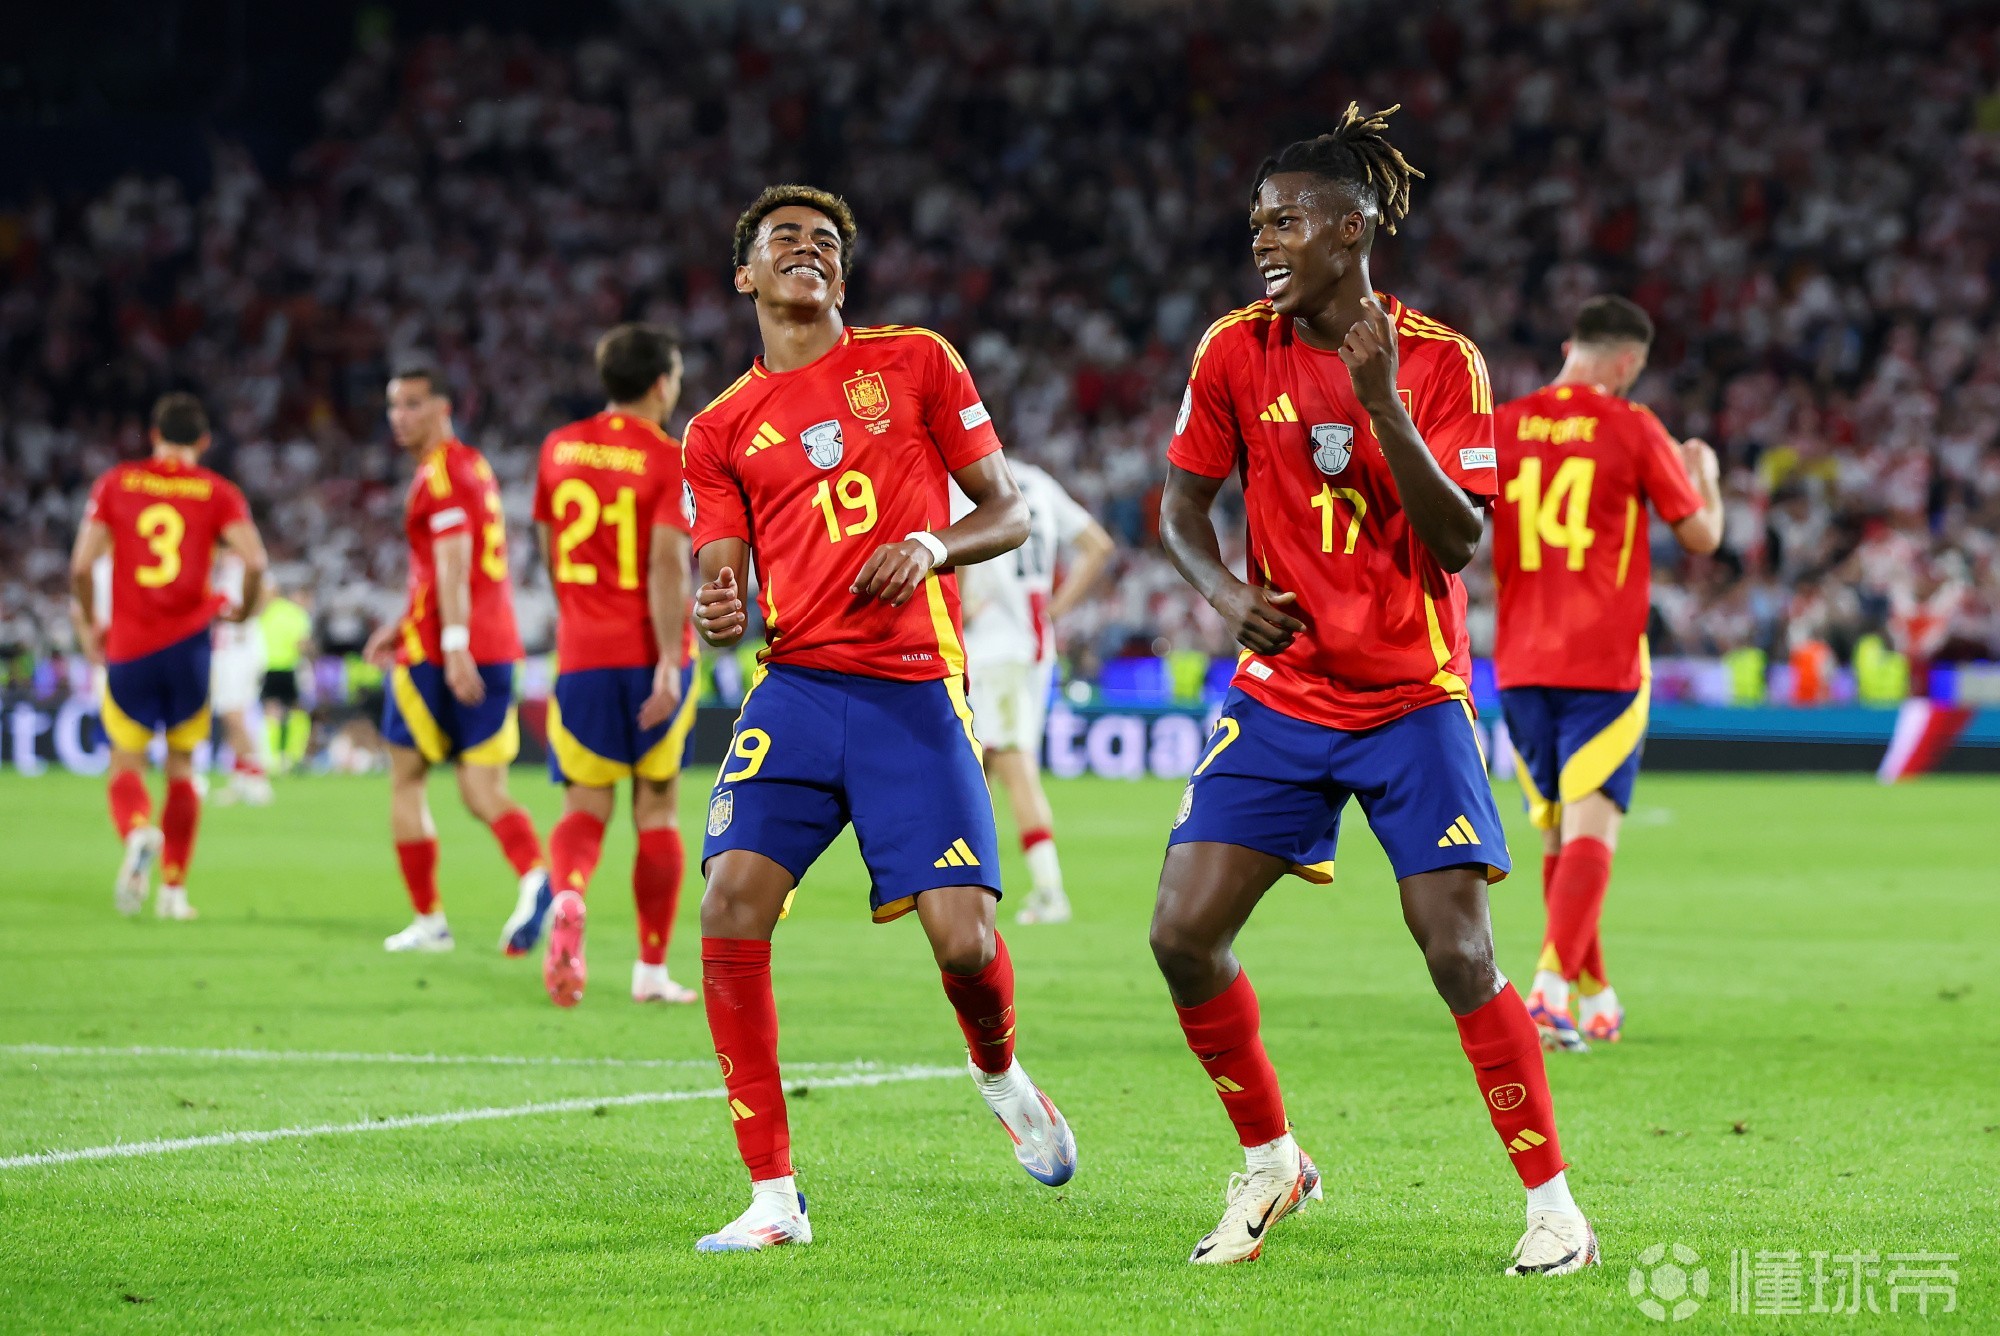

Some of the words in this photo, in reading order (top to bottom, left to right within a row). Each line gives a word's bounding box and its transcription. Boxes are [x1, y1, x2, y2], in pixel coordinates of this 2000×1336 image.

[135, 502, 186, 588] 3
[551, 478, 640, 590] 21
[811, 469, 878, 544] 19
[1310, 482, 1367, 555] 17
[1505, 456, 1596, 572] 14
[1193, 717, 1241, 777] 7
